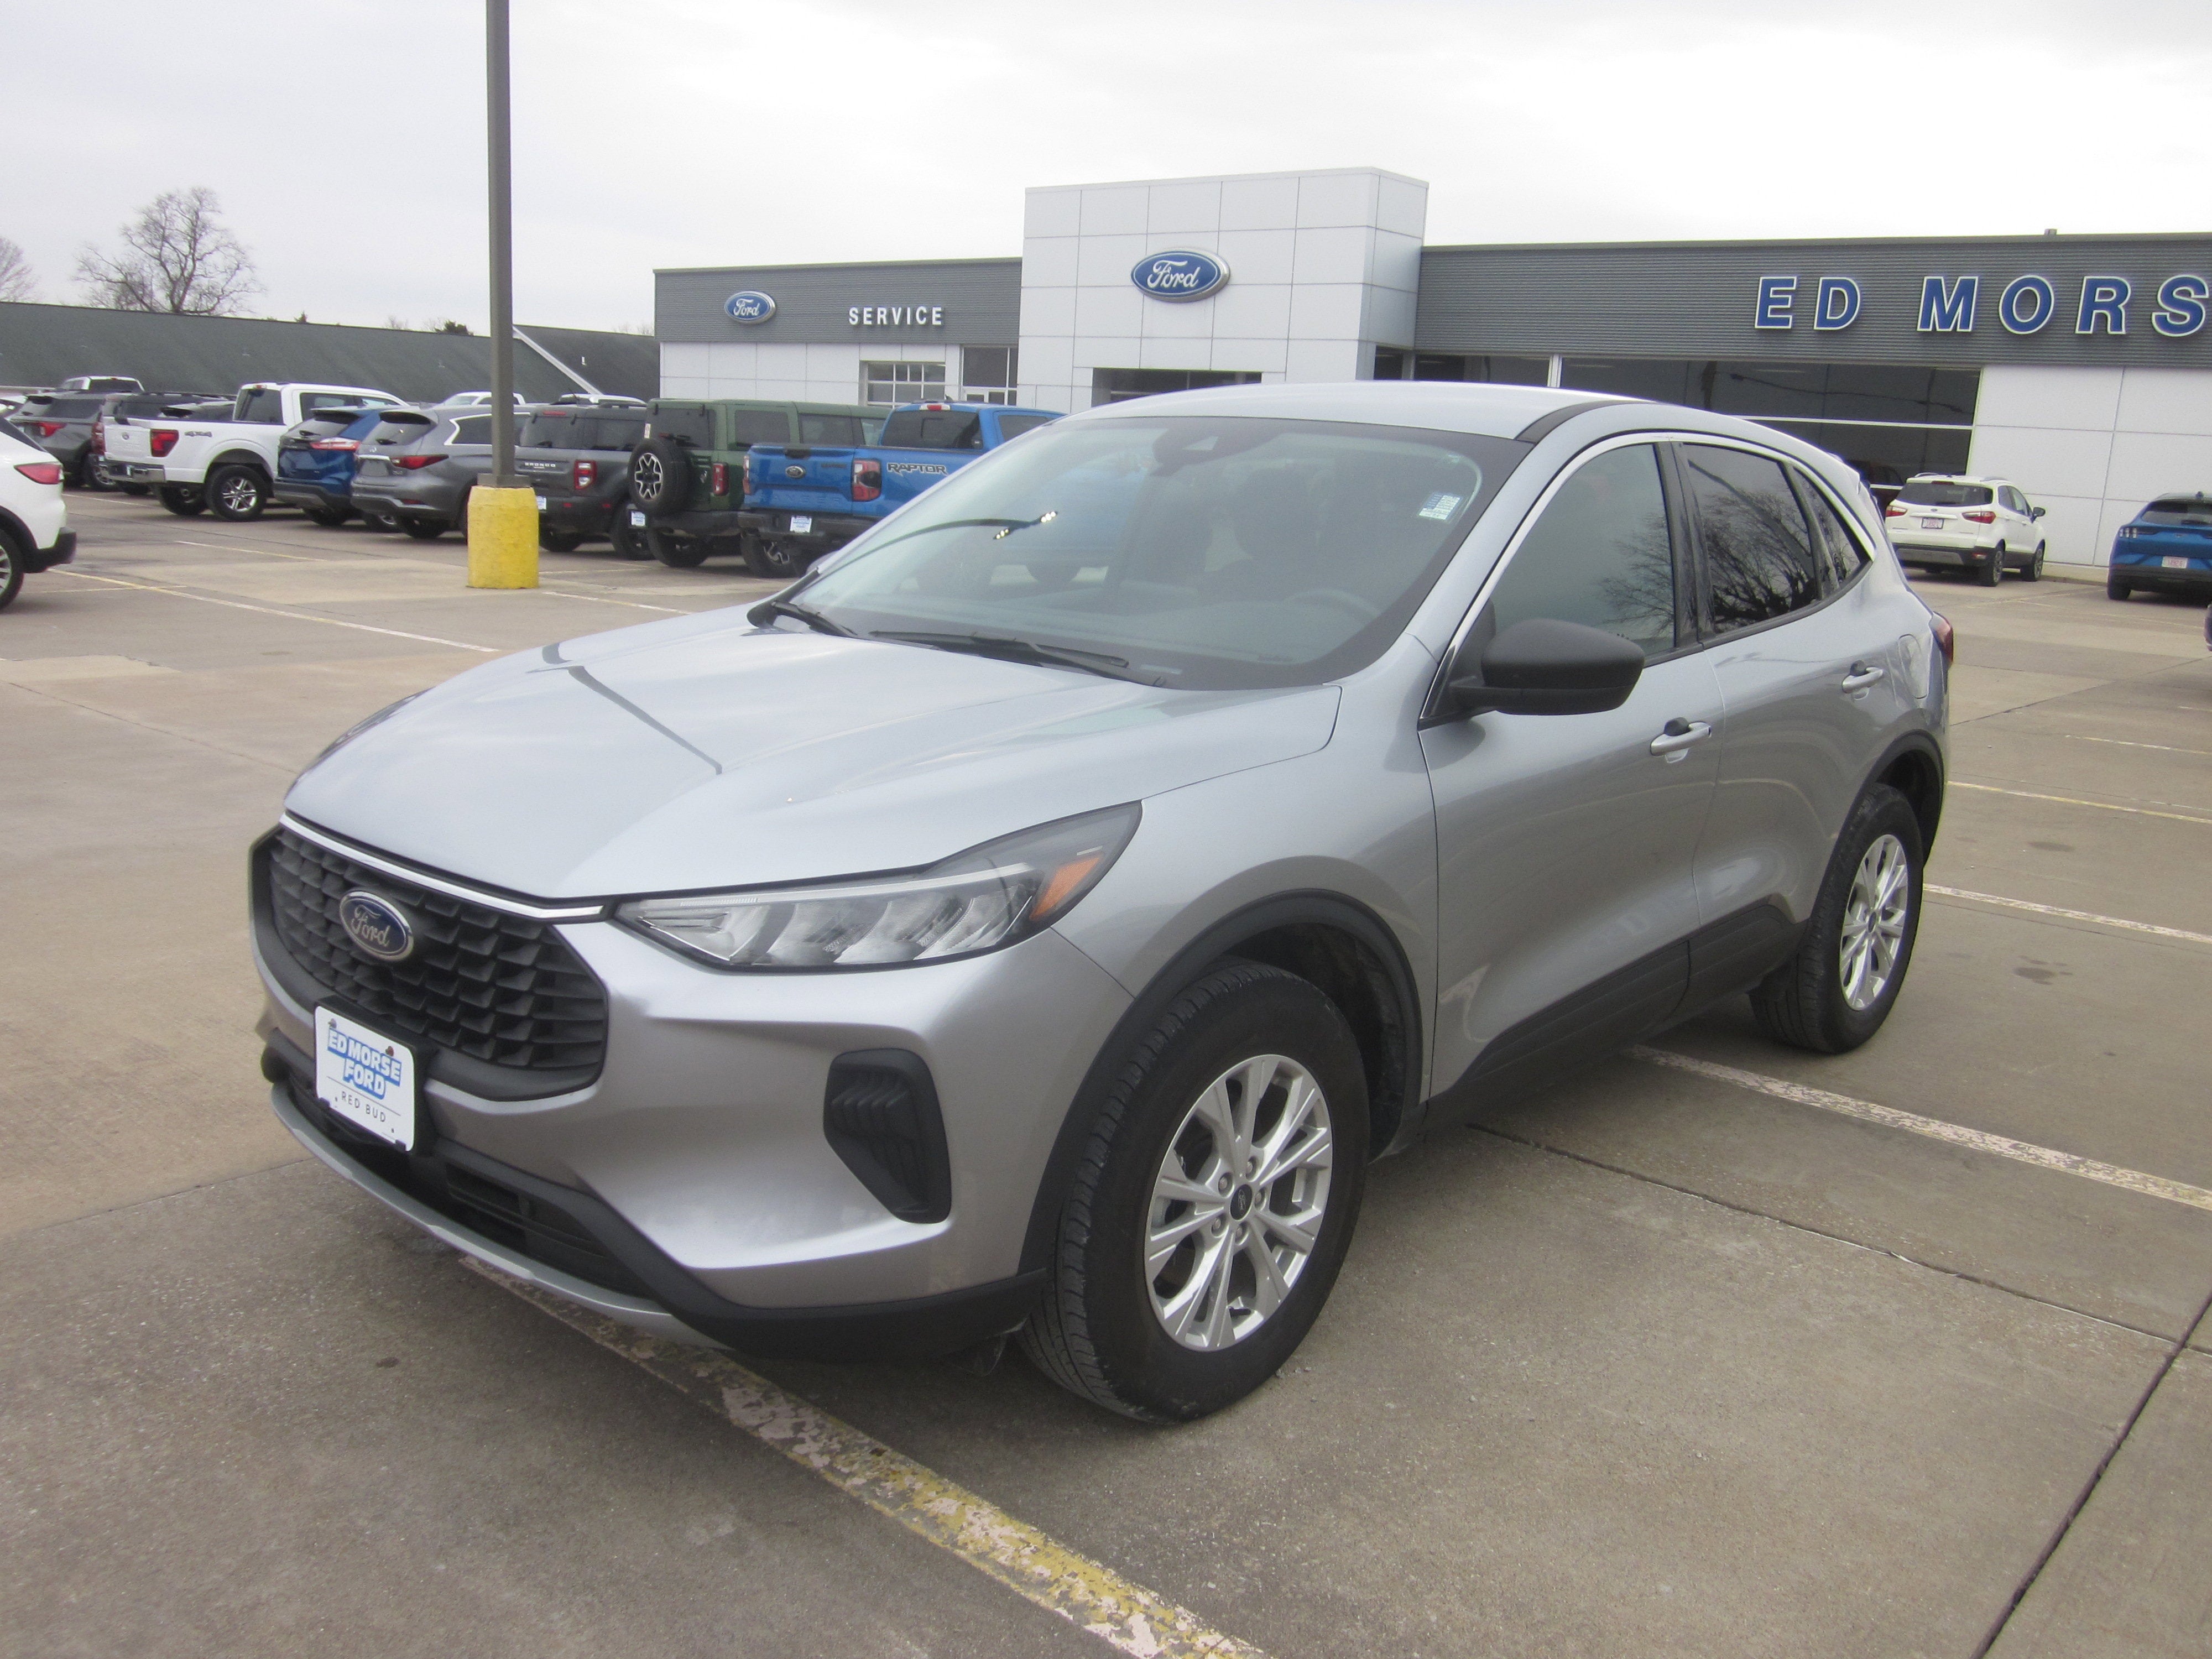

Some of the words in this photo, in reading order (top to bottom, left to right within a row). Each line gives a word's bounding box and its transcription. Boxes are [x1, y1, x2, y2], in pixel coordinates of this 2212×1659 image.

[1147, 259, 1201, 289] Ford
[733, 298, 760, 317] Ford
[848, 306, 942, 326] SERVICE
[1754, 275, 1861, 330] ED
[1916, 274, 2210, 337] MORS
[887, 462, 948, 476] RAPTOR
[350, 904, 391, 947] Ford
[328, 1028, 348, 1056] ED
[348, 1036, 402, 1087] MORSE
[343, 1058, 386, 1099] FORD
[341, 1091, 360, 1108] RED
[365, 1104, 387, 1123] BUD
